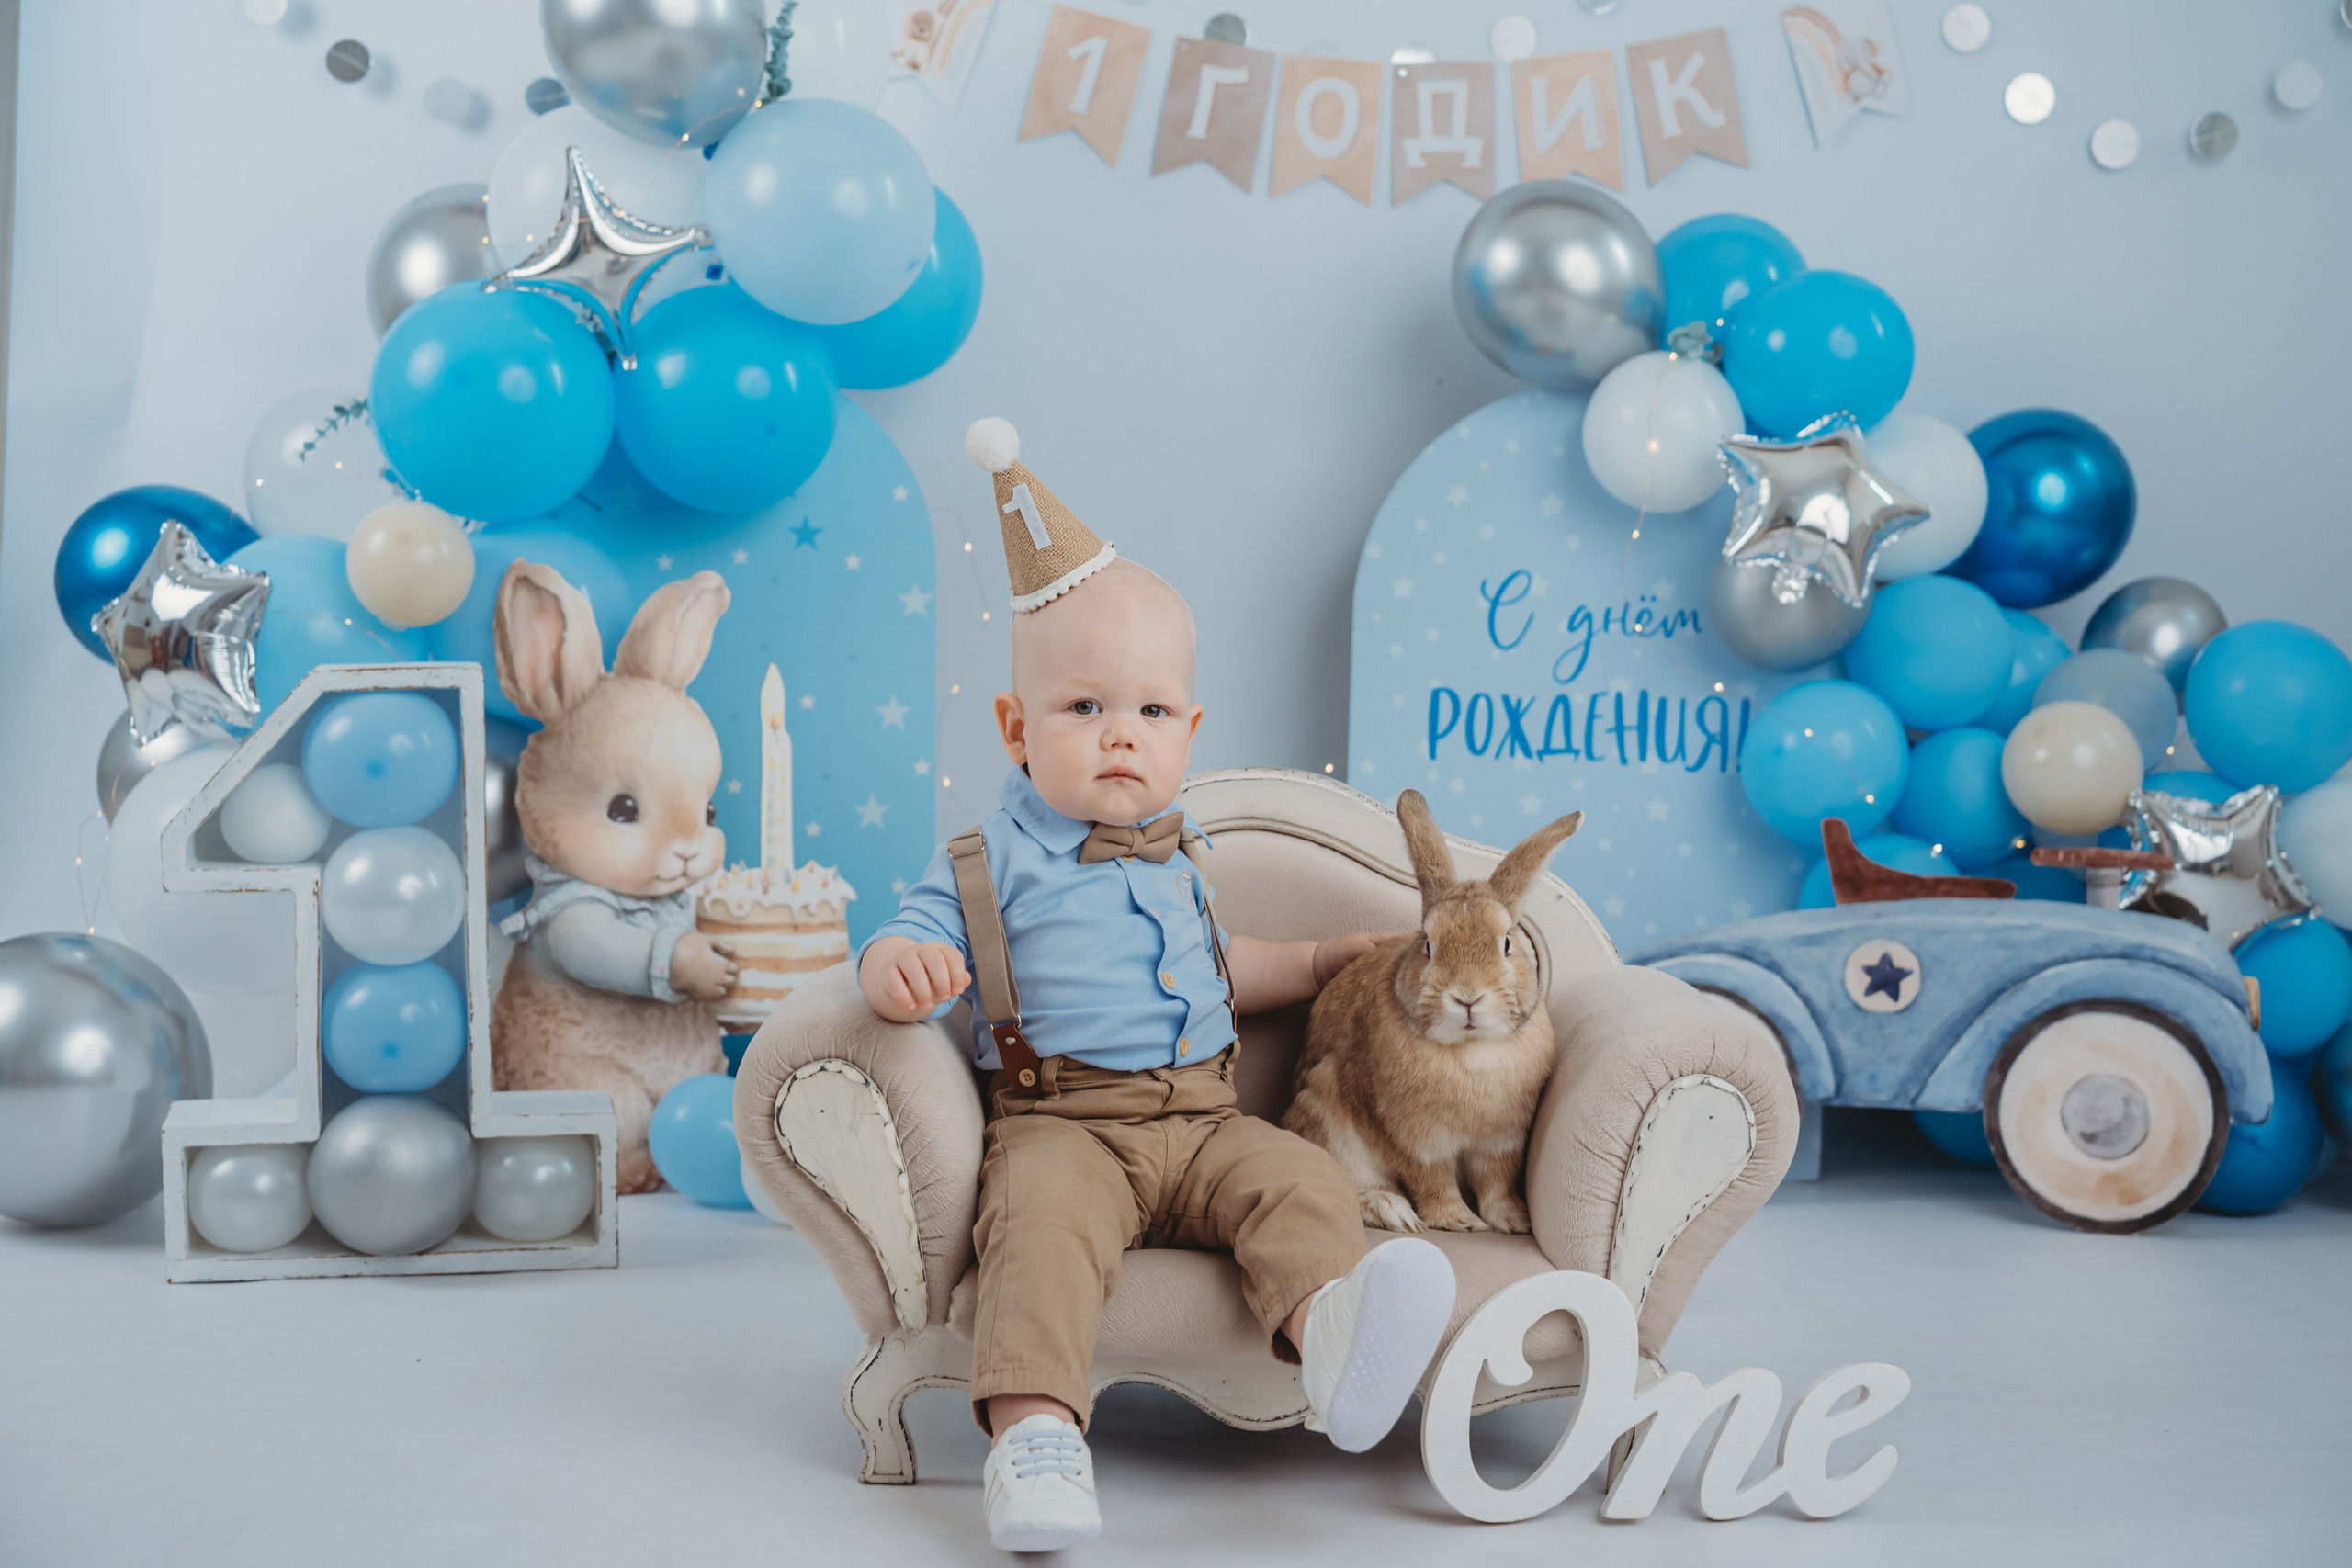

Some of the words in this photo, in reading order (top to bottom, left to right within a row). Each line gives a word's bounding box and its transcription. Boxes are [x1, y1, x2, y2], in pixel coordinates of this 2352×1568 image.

[1068, 35, 1108, 117] 1
[1186, 50, 1726, 167] ГОДИК
[1002, 482, 1051, 551] 1
[1480, 570, 1534, 650] С
[1552, 594, 1702, 684] днём
[1428, 686, 1750, 773] РОЖДЕНИЯ!
[1420, 1269, 1911, 1524] One
